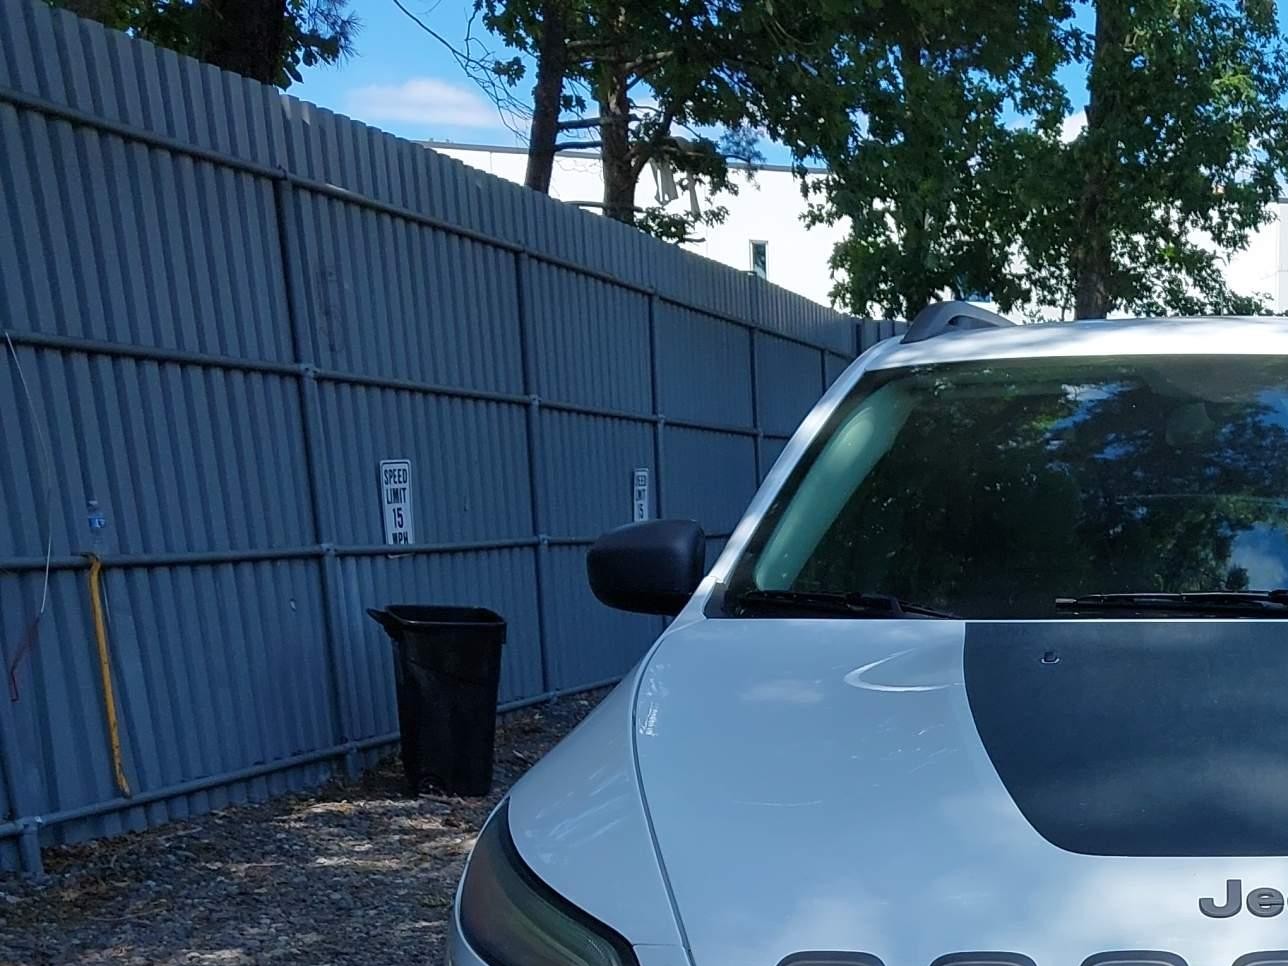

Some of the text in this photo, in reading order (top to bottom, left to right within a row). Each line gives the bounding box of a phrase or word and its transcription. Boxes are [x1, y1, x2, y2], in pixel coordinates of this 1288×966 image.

[383, 468, 408, 486] SPEED
[385, 487, 407, 505] LIMIT
[392, 507, 404, 529] 15
